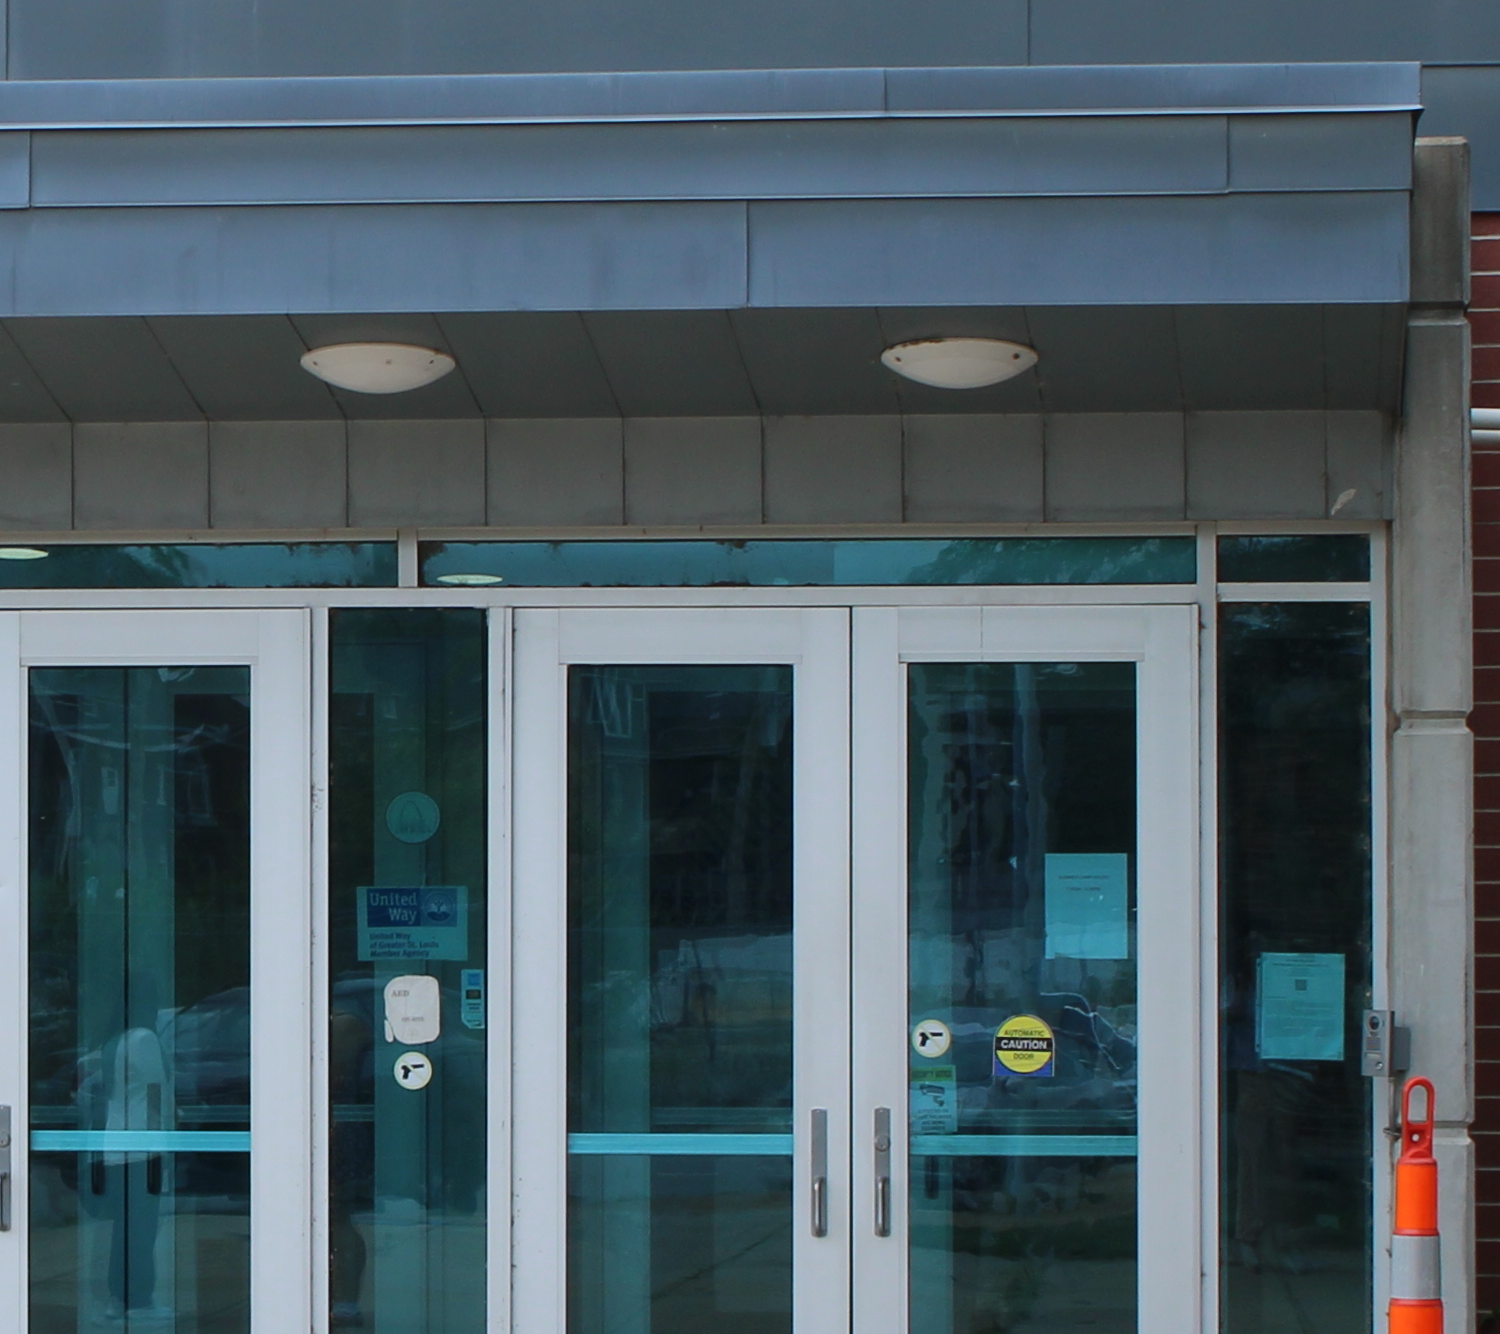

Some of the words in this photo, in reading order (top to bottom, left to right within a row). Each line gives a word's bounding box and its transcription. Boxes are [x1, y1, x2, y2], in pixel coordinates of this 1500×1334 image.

[369, 892, 418, 906] United
[388, 908, 418, 925] Way
[391, 989, 410, 997] AED
[1003, 1029, 1045, 1037] AUTOMATIC
[1000, 1039, 1048, 1050] CAUTION
[1012, 1052, 1035, 1060] DOOR
